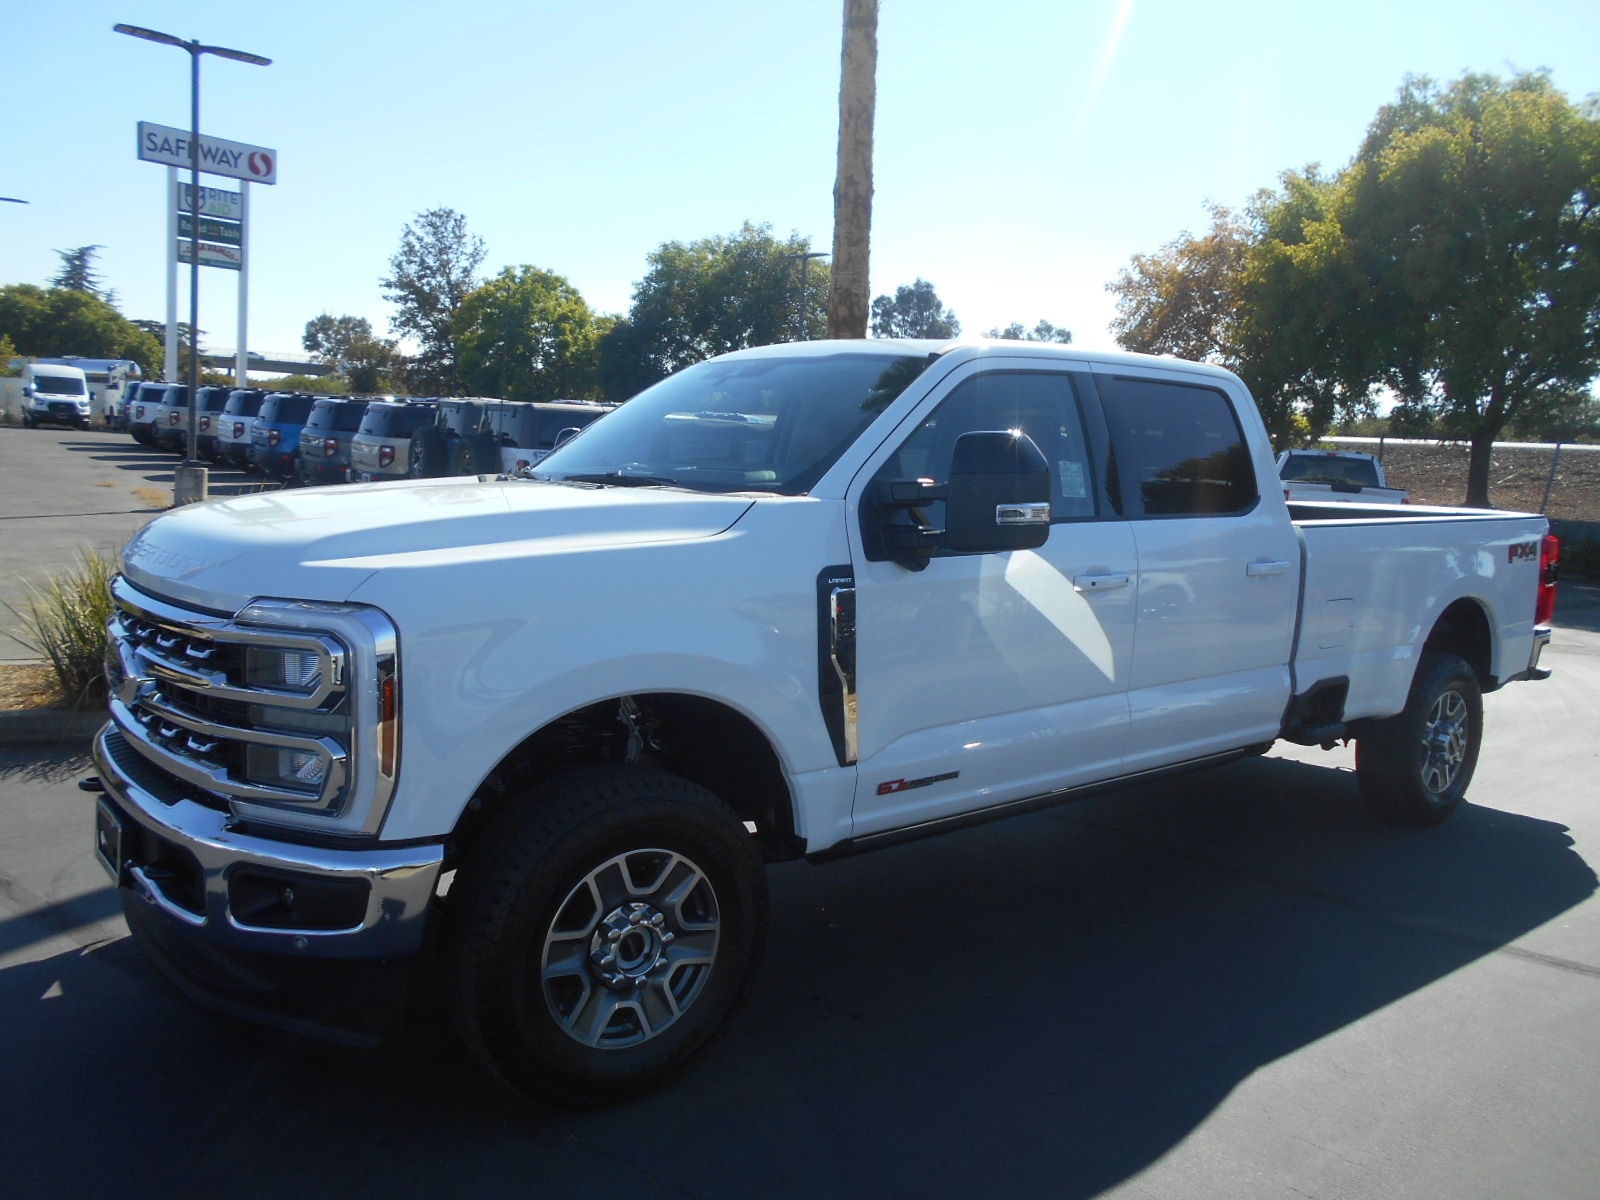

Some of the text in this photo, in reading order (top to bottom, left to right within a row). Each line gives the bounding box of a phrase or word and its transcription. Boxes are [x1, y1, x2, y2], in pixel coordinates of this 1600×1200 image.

[209, 188, 239, 205] RITE
[208, 202, 230, 215] AID
[181, 220, 207, 233] Rod
